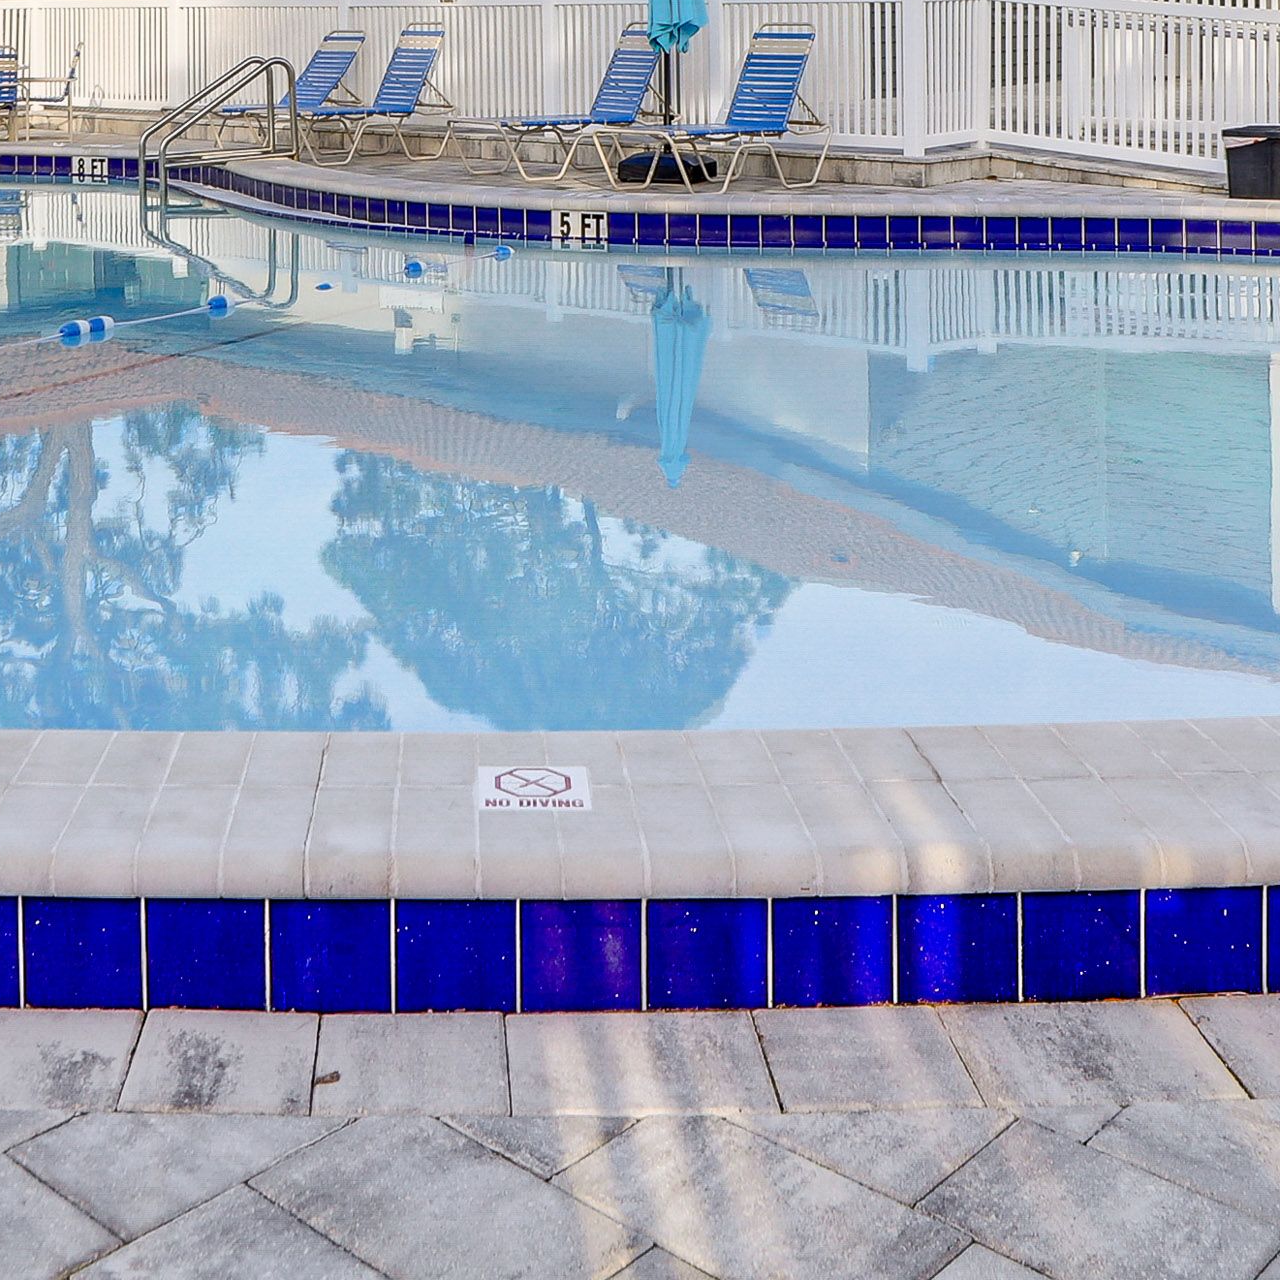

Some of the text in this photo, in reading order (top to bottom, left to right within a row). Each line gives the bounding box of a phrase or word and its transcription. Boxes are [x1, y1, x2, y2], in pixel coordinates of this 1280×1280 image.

[77, 157, 106, 176] 8 FT
[560, 211, 604, 239] 5 FT
[485, 798, 585, 808] NO DIVING
